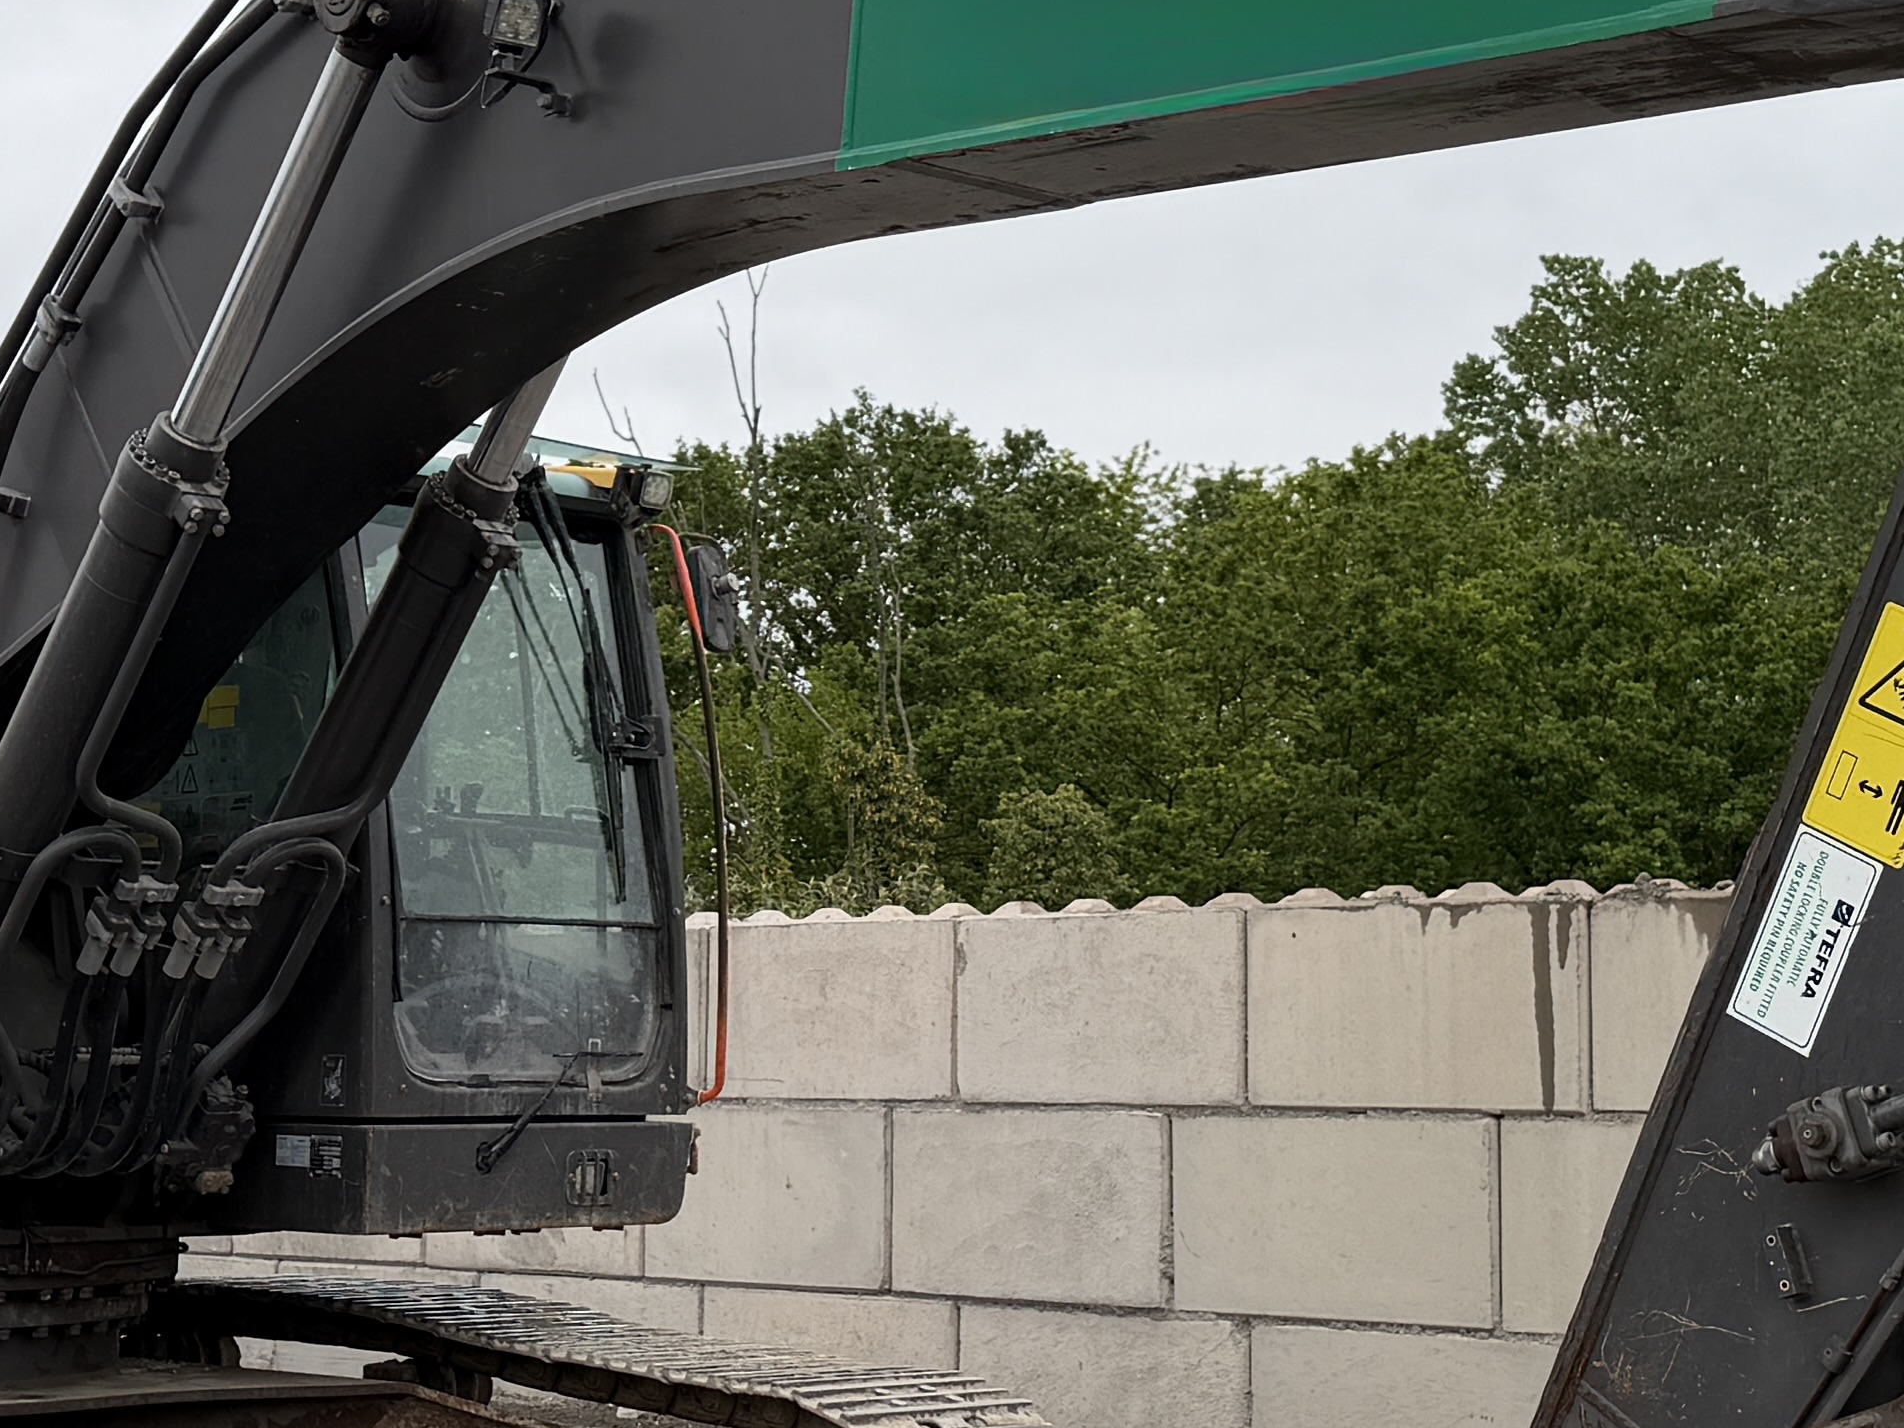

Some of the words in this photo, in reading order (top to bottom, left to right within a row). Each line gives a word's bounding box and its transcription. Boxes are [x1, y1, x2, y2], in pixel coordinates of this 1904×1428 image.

[1794, 861, 1808, 879] NO
[1806, 850, 1829, 891] DOUBLE
[1778, 878, 1800, 919] SAFETY
[1788, 892, 1813, 936] LOCKING
[1809, 897, 1829, 930] FULLY
[1770, 917, 1785, 939] PIN
[1749, 939, 1777, 992] REQUIRED
[1770, 936, 1795, 983] COUPLER
[1786, 928, 1818, 987] AUTOMATIC
[1800, 928, 1841, 998] TEFRA
[1757, 983, 1777, 1018] FITTED
